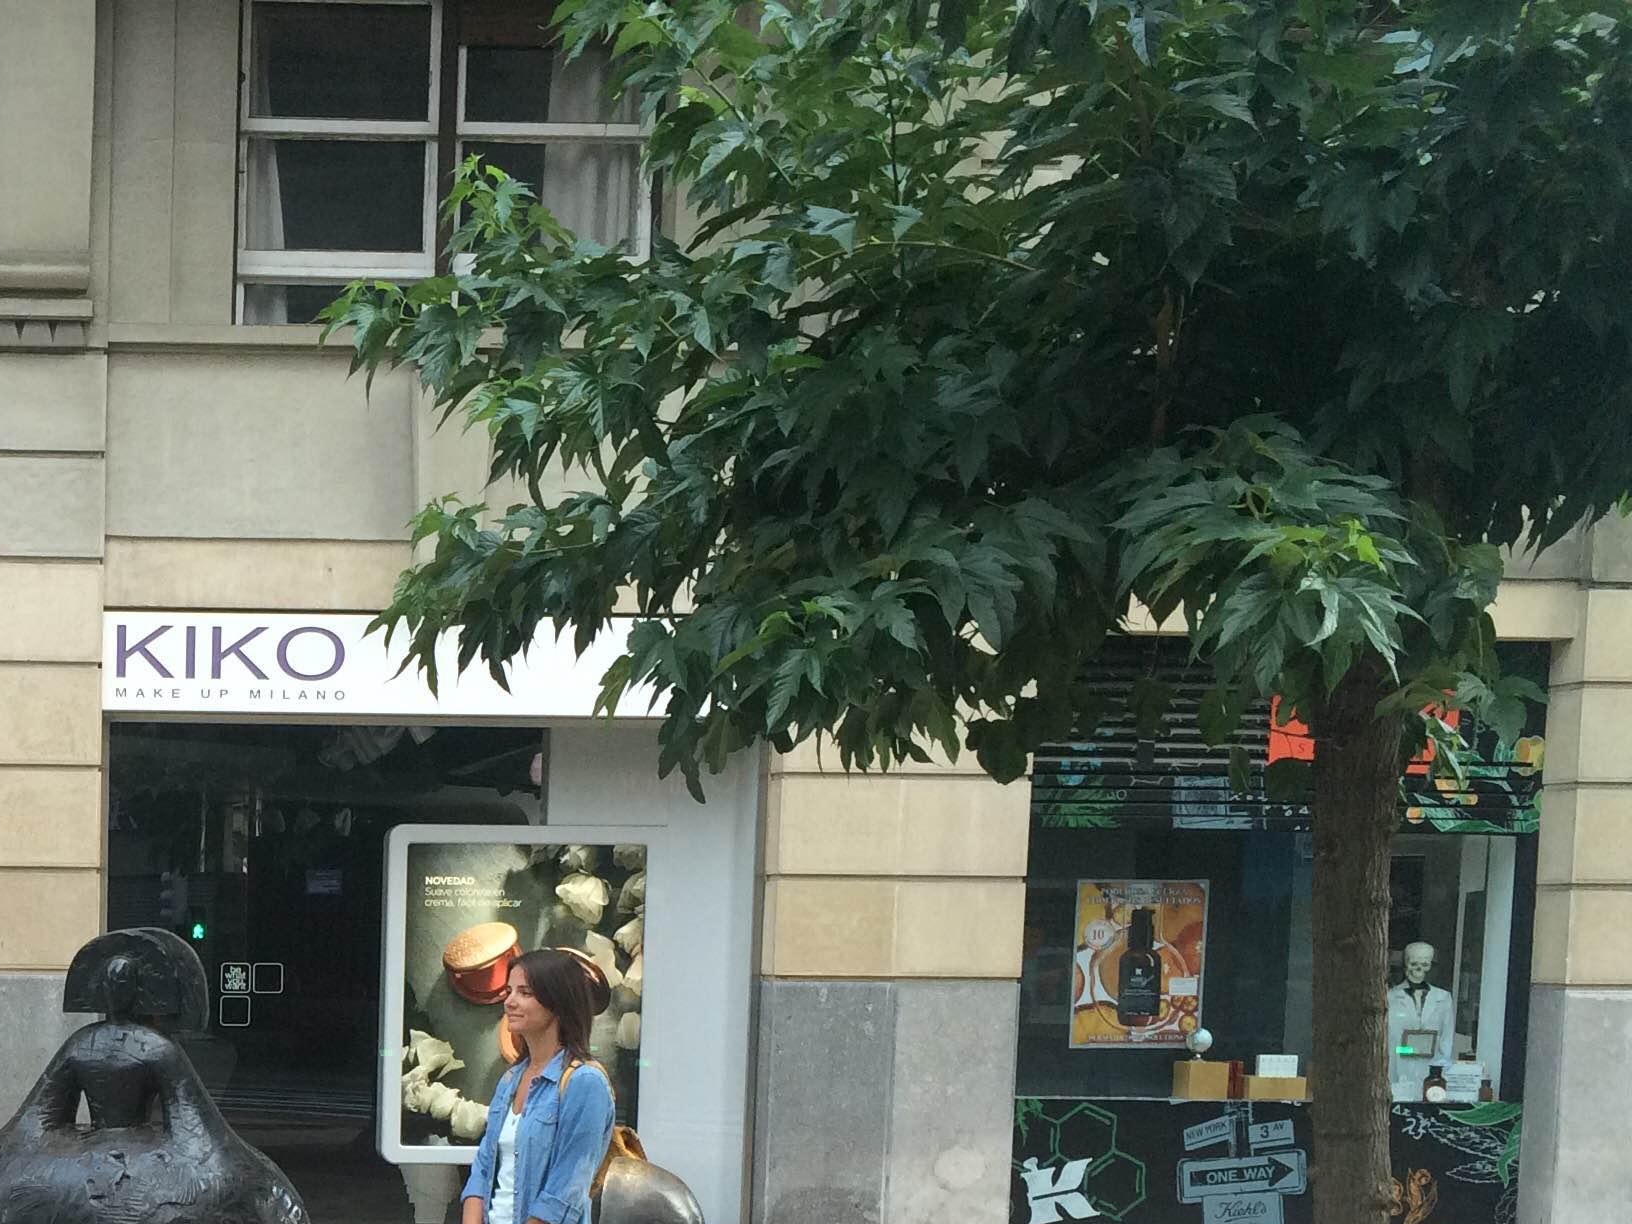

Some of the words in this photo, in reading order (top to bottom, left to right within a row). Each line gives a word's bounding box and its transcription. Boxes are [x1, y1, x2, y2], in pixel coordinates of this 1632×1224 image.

[116, 624, 346, 681] KIKO
[115, 687, 181, 699] MAKE
[200, 688, 229, 699] UP
[249, 689, 346, 701] MILANO
[425, 876, 475, 886] NOVEDAD
[1092, 929, 1105, 940] 10
[1185, 1128, 1204, 1140] NEW
[1205, 1121, 1227, 1134] YORK
[1260, 1126, 1269, 1138] 3
[1272, 1122, 1285, 1131] AV
[1206, 1170, 1237, 1184] ONE
[1244, 1167, 1275, 1179] WAY
[1214, 1200, 1267, 1218] Kiehl's
